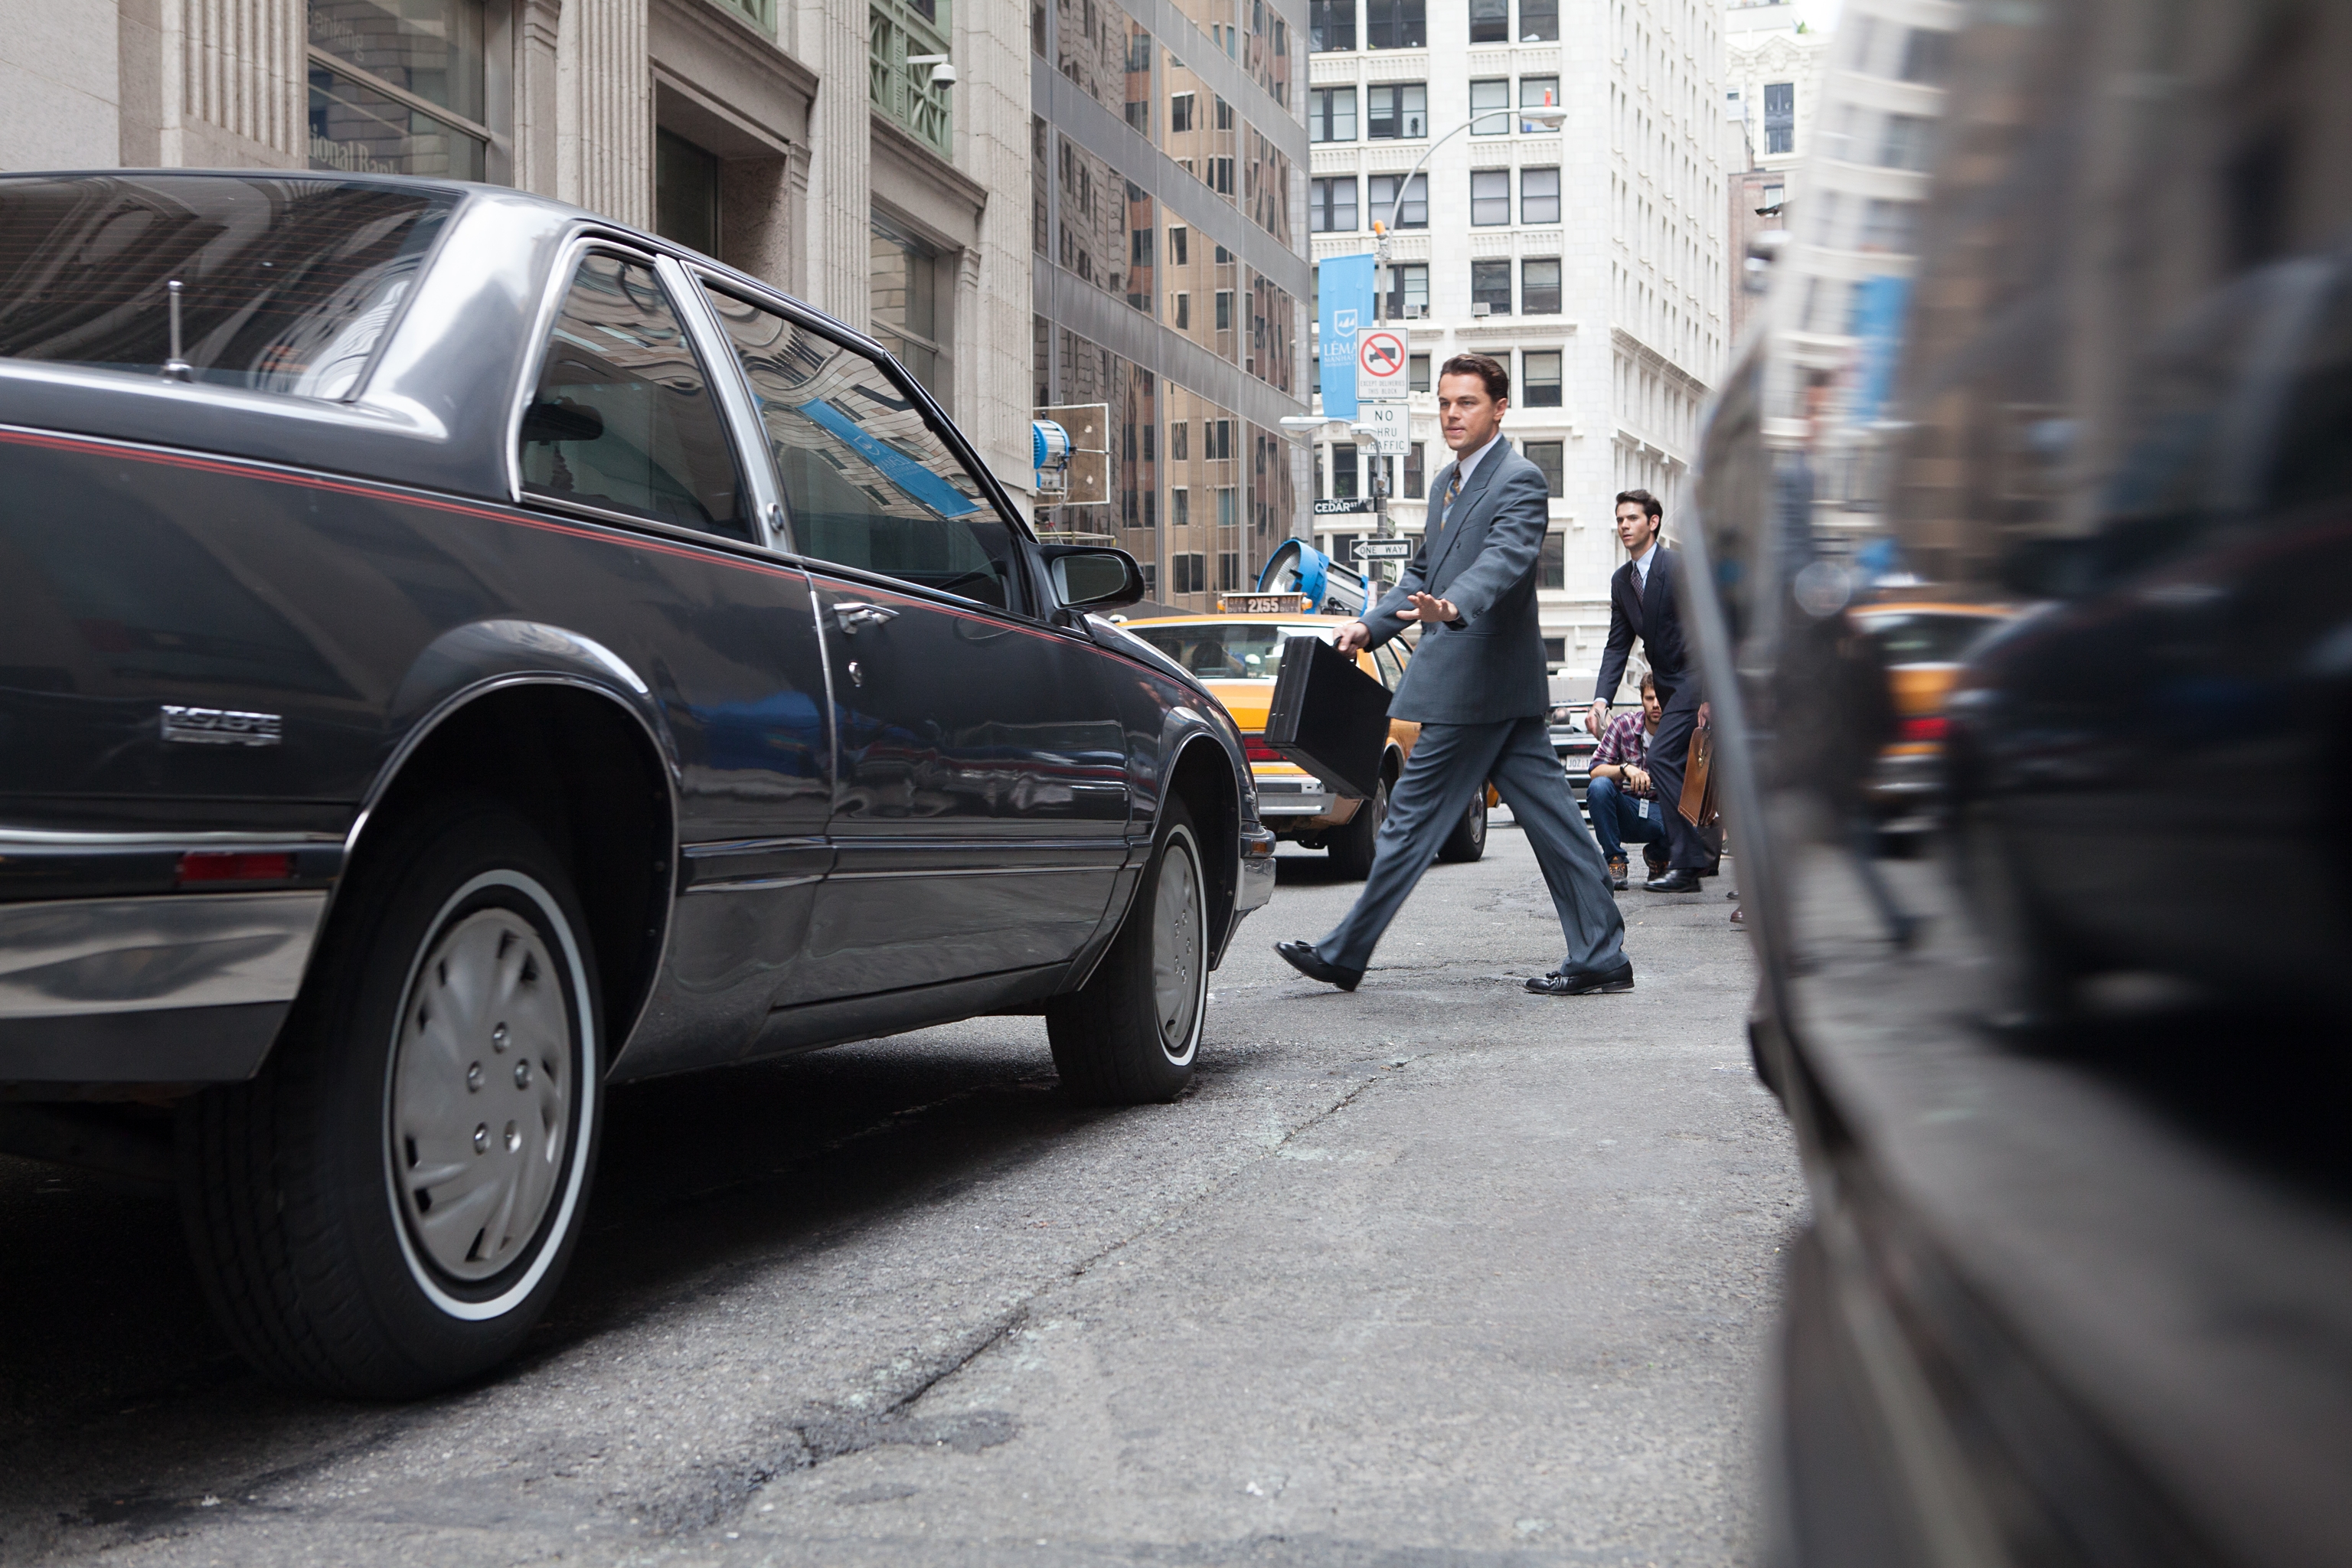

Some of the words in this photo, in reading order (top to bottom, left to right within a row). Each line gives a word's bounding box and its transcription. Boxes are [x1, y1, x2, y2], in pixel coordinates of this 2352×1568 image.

[308, 2, 365, 61] anking
[1324, 340, 1356, 356] LÉMA
[1375, 410, 1393, 421] NO
[1377, 427, 1397, 437] HRU
[1315, 502, 1351, 513] CEDAR
[1360, 546, 1377, 554] ONE
[1385, 546, 1403, 554] WAY
[1248, 598, 1279, 612] 2X55
